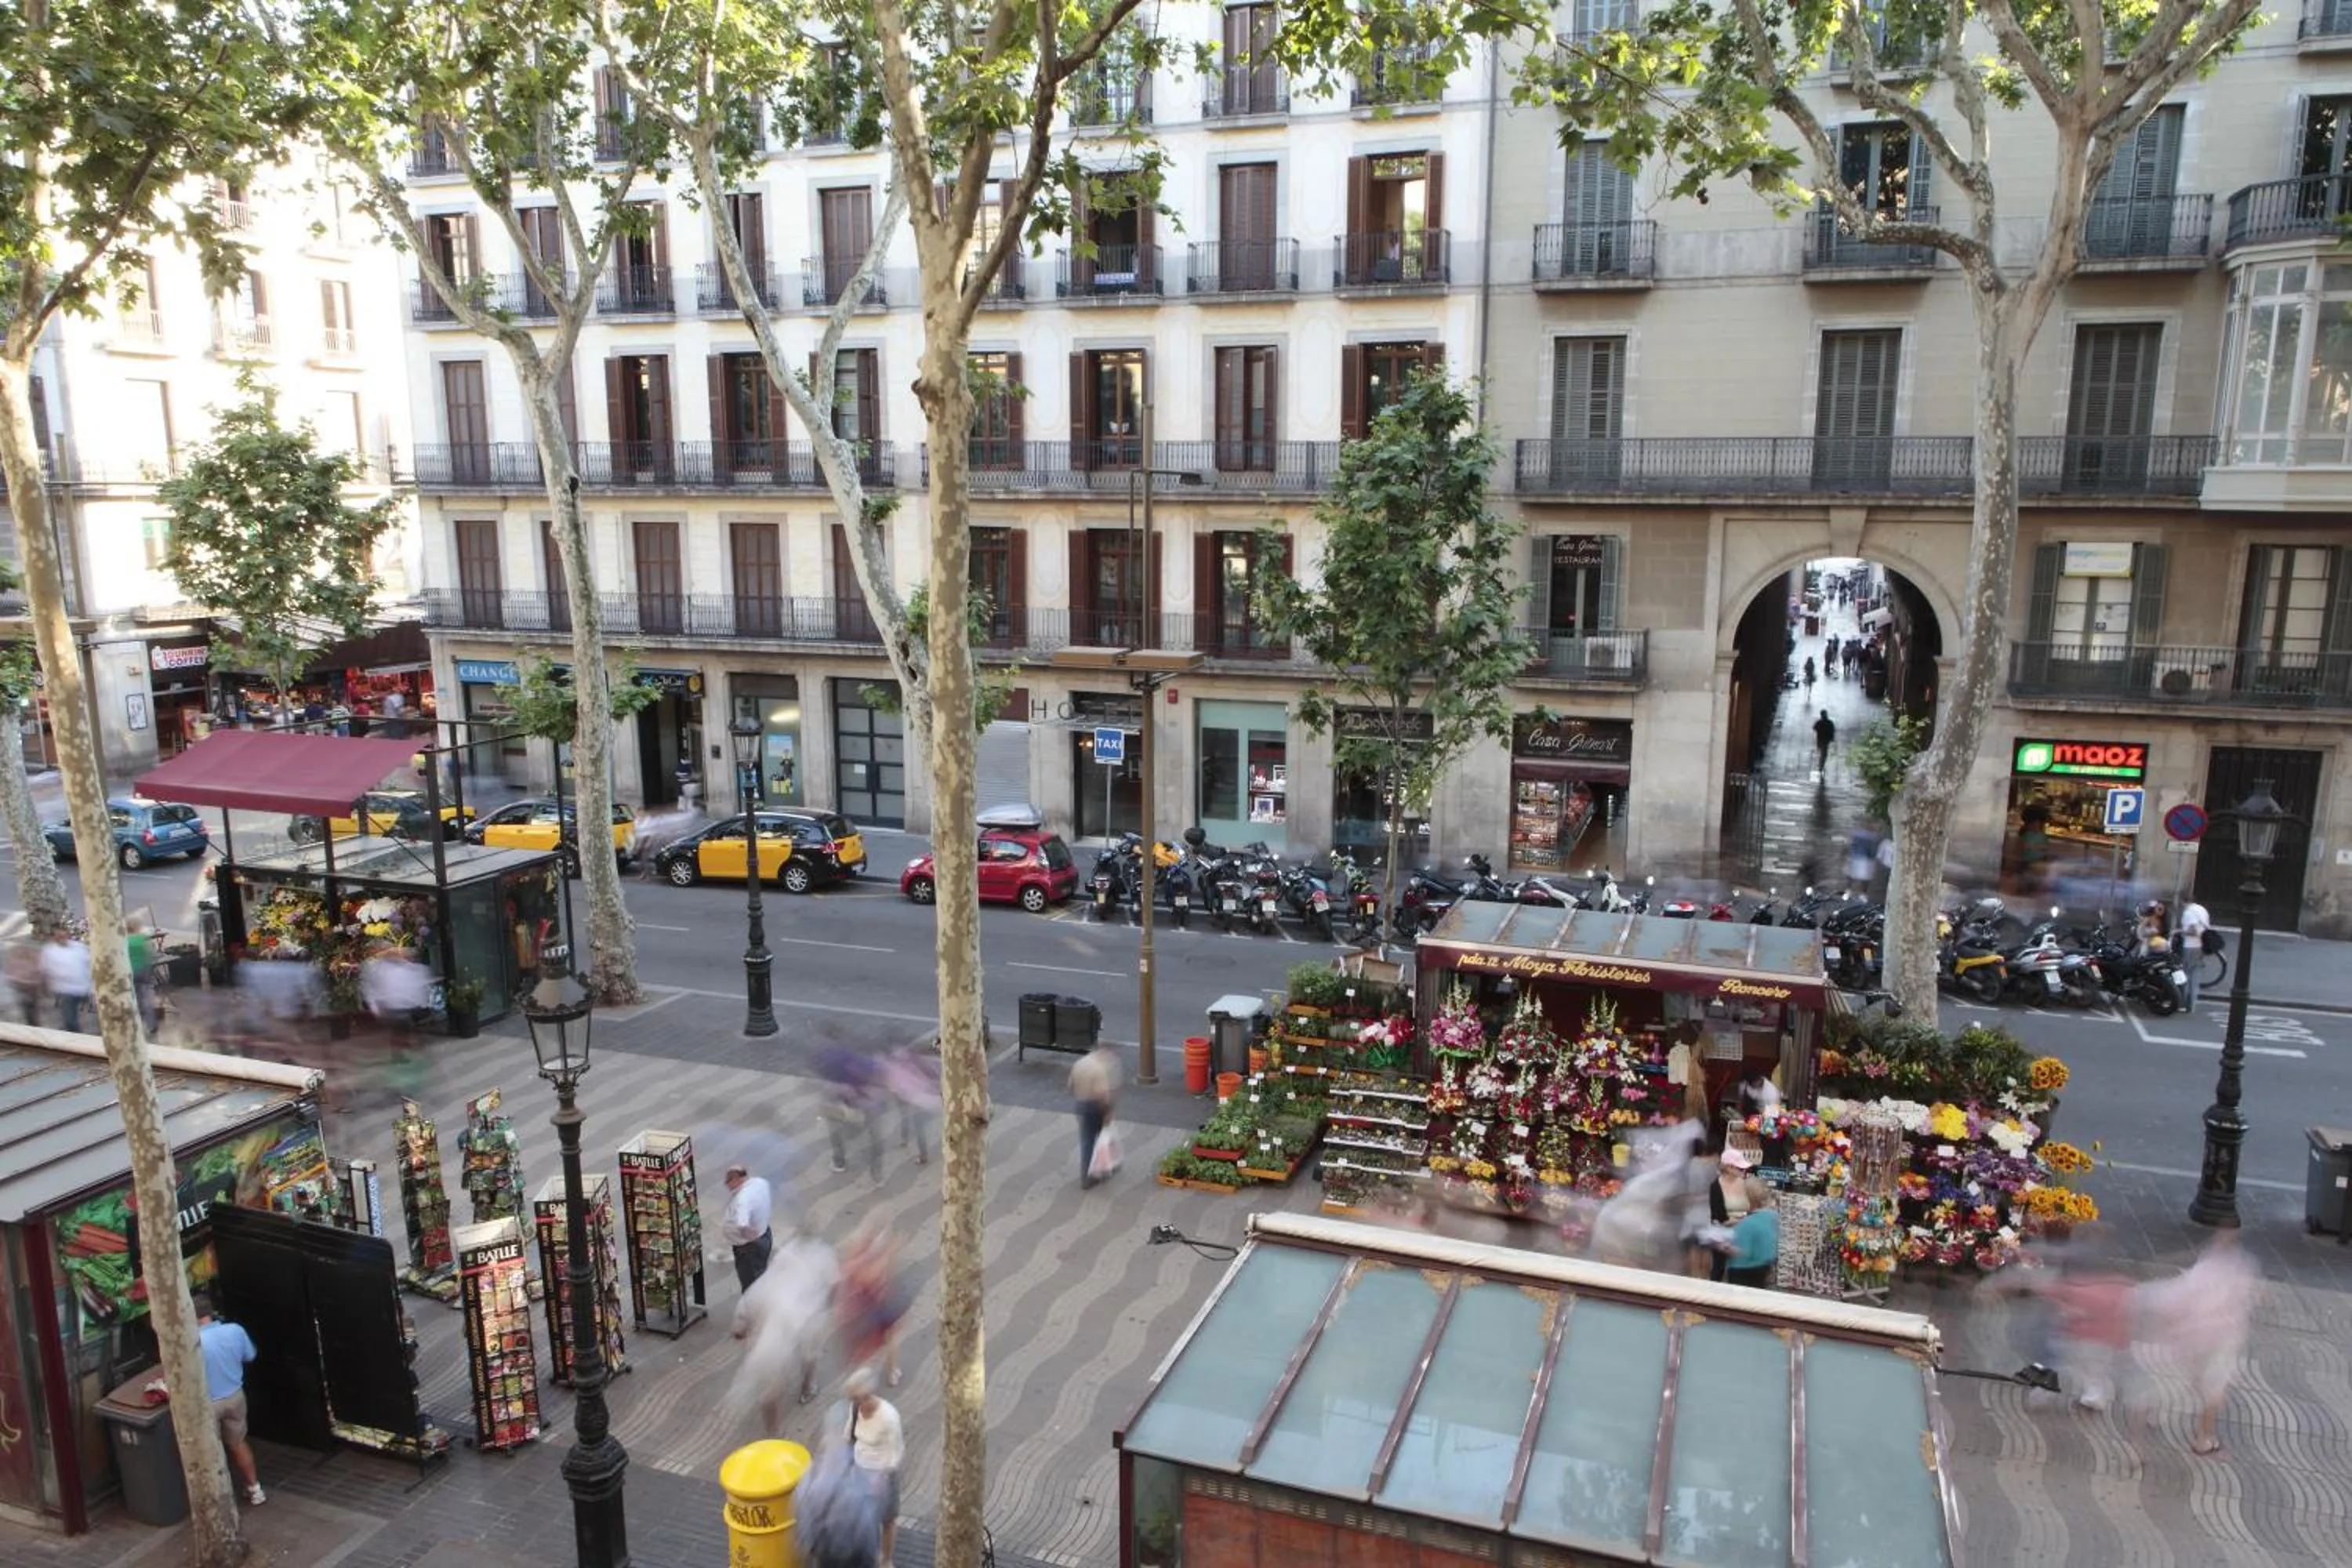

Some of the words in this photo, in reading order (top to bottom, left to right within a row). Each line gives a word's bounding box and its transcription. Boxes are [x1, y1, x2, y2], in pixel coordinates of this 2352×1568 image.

[1098, 739, 1123, 750] TAXI
[2054, 744, 2143, 766] maoz
[2113, 794, 2136, 822] P
[1503, 954, 1556, 978] Moya
[1718, 978, 1791, 999] Roncero
[631, 1156, 661, 1169] BATLLE
[477, 1244, 518, 1264] BATLLE
